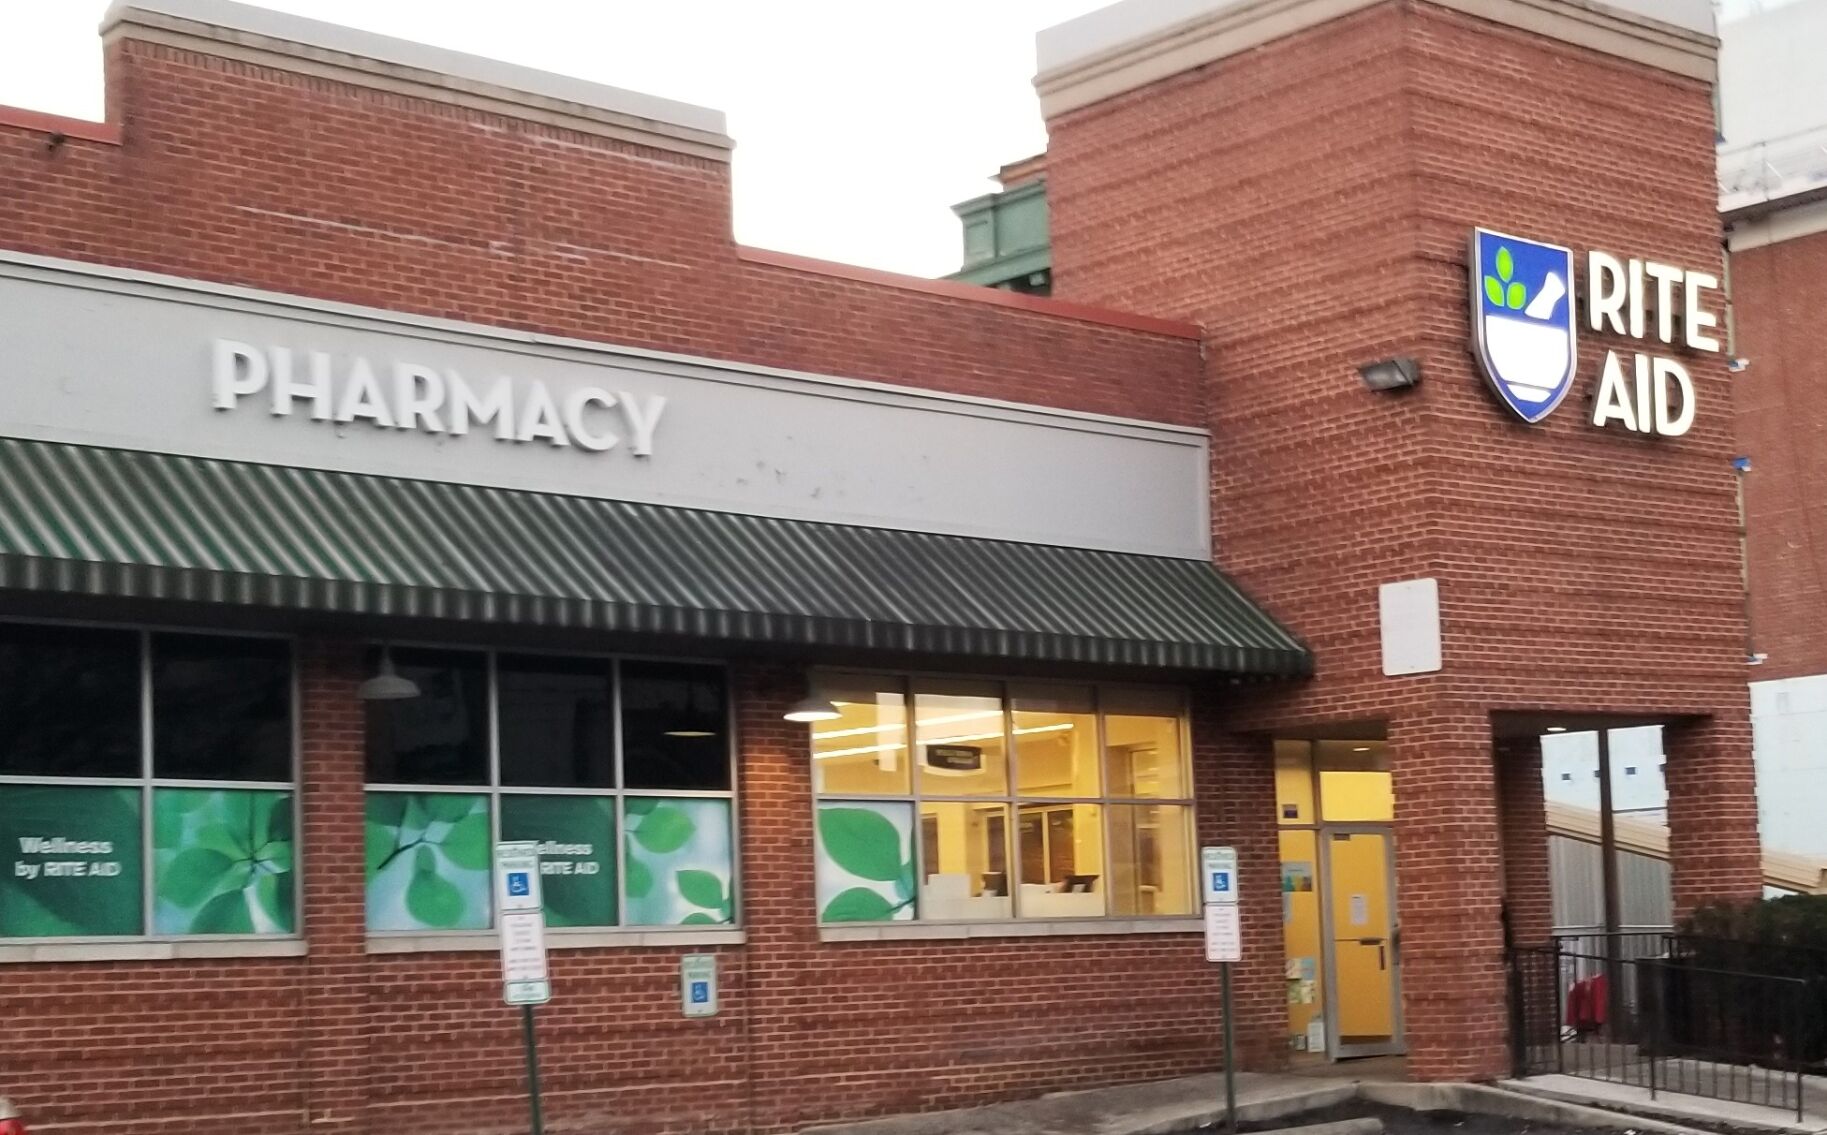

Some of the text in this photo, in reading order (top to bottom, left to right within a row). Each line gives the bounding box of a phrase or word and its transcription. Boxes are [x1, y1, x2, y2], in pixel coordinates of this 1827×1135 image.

[1588, 250, 1720, 353] RITE
[212, 338, 667, 457] PHARMACY
[1593, 349, 1696, 437] AID
[18, 836, 113, 854] Wellness
[537, 840, 593, 855] ellness
[14, 860, 121, 879] by RITE AID
[574, 861, 599, 875] AID
